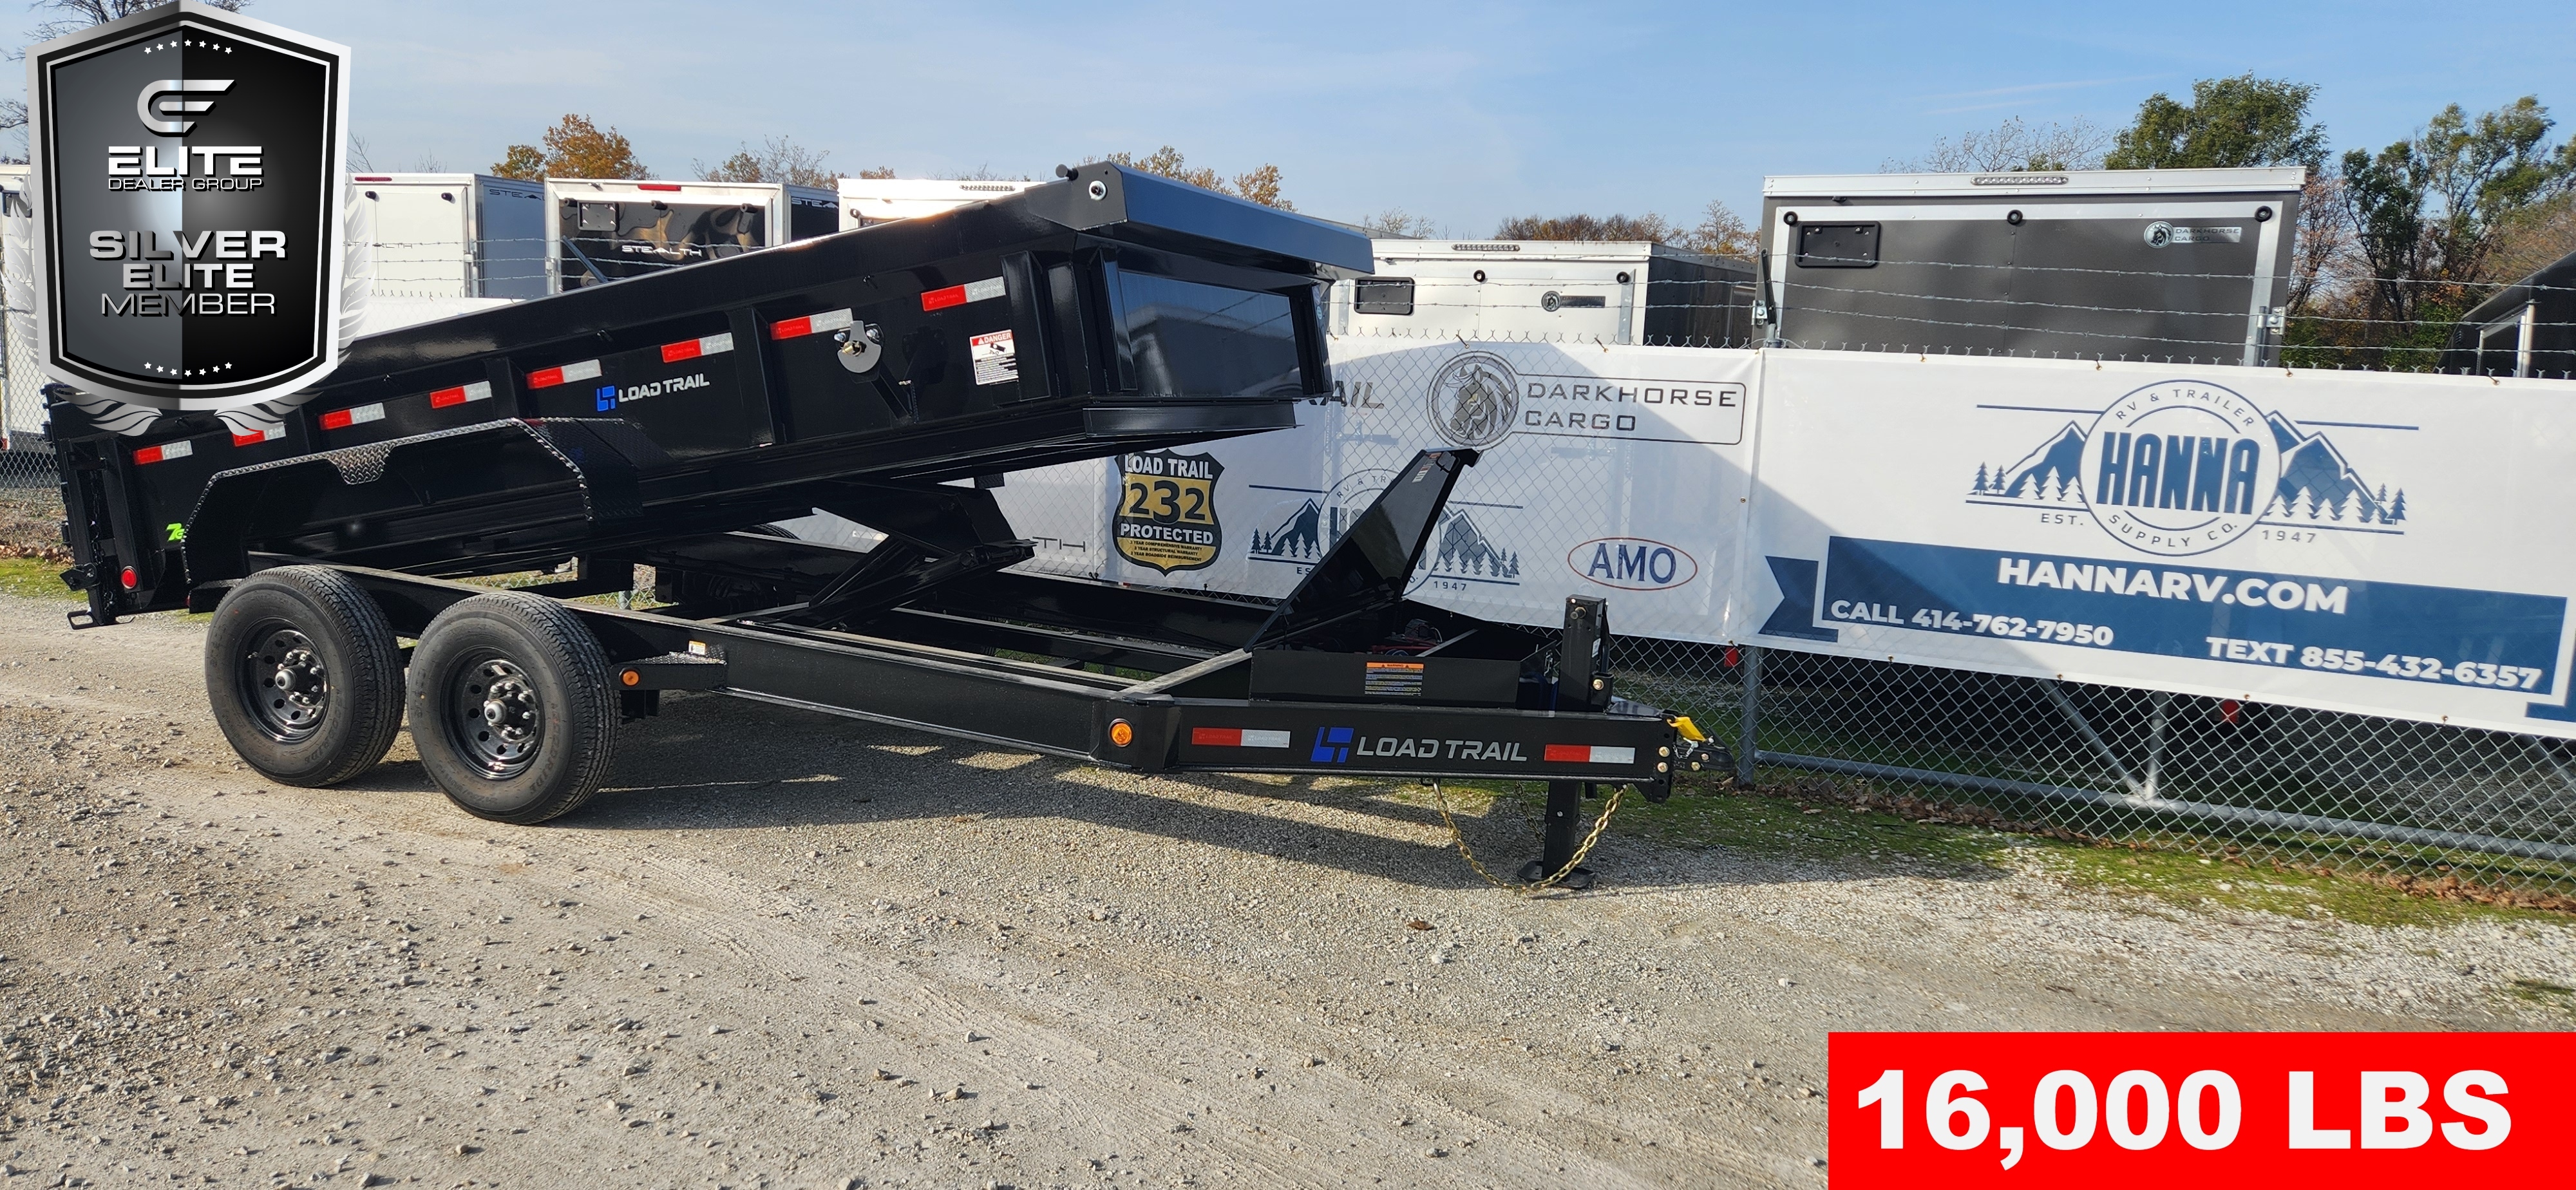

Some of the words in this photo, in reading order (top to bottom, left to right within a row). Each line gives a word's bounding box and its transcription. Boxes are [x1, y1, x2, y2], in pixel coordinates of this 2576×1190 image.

[621, 245, 702, 257] STEALTH
[983, 332, 1012, 343] DANGER
[618, 381, 661, 403] LOAD
[663, 373, 710, 393] TRAIL
[1527, 382, 1737, 408] DARKHORSE
[2116, 402, 2137, 420] RV
[2150, 393, 2160, 402] &
[2172, 389, 2255, 426] TRAILER
[1524, 410, 1636, 431] CARGO
[1124, 455, 1163, 474] LOAD
[1168, 458, 1213, 479] TRAIL
[2096, 430, 2260, 515] HANNA
[1129, 480, 1206, 524] 232
[1336, 484, 1350, 498] RV
[2040, 513, 2084, 525] EST.
[2108, 514, 2190, 548] SUPPLY
[2207, 522, 2238, 541] CO.
[1120, 523, 1213, 544] PROTECTED
[2261, 529, 2317, 544] 1947
[1587, 542, 1676, 585] AMO
[1434, 580, 1467, 591] 1947
[1997, 557, 2349, 615] HANNARV.COM
[1830, 599, 1904, 625] CALL
[1911, 608, 2114, 646] 414-762-7950
[2205, 636, 2294, 665] TEXT
[2300, 646, 2543, 690] 855-432-6357
[1356, 736, 1439, 758] LOAD
[1445, 740, 1528, 761] TRAIL
